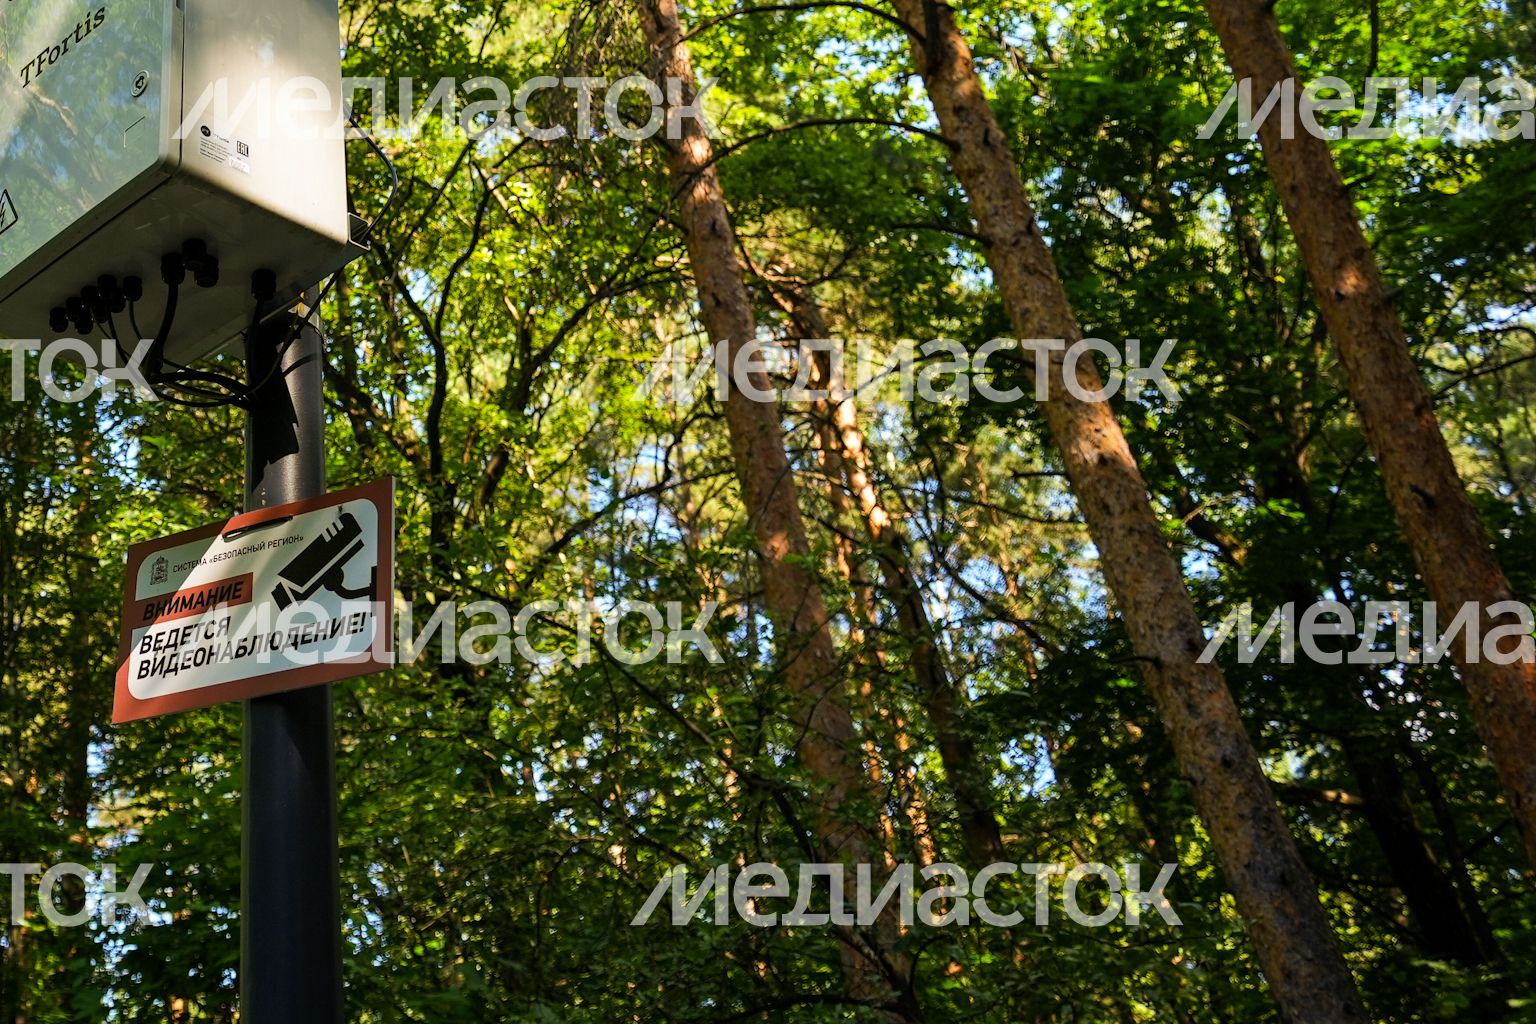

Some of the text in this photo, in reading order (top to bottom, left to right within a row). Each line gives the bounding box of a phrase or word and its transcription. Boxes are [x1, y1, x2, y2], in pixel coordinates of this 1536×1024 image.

[20, 6, 105, 89] TFortis
[172, 534, 305, 573] СИСТЕМА «БЕЗОПАСНЫЙ РЕГИОН»
[143, 581, 244, 621] ВНИМАНИЕ
[137, 611, 368, 681] ВИДЕОНАБЛЮДЕНИЕ!
[139, 616, 231, 656] ВЕДЕТСЯ
